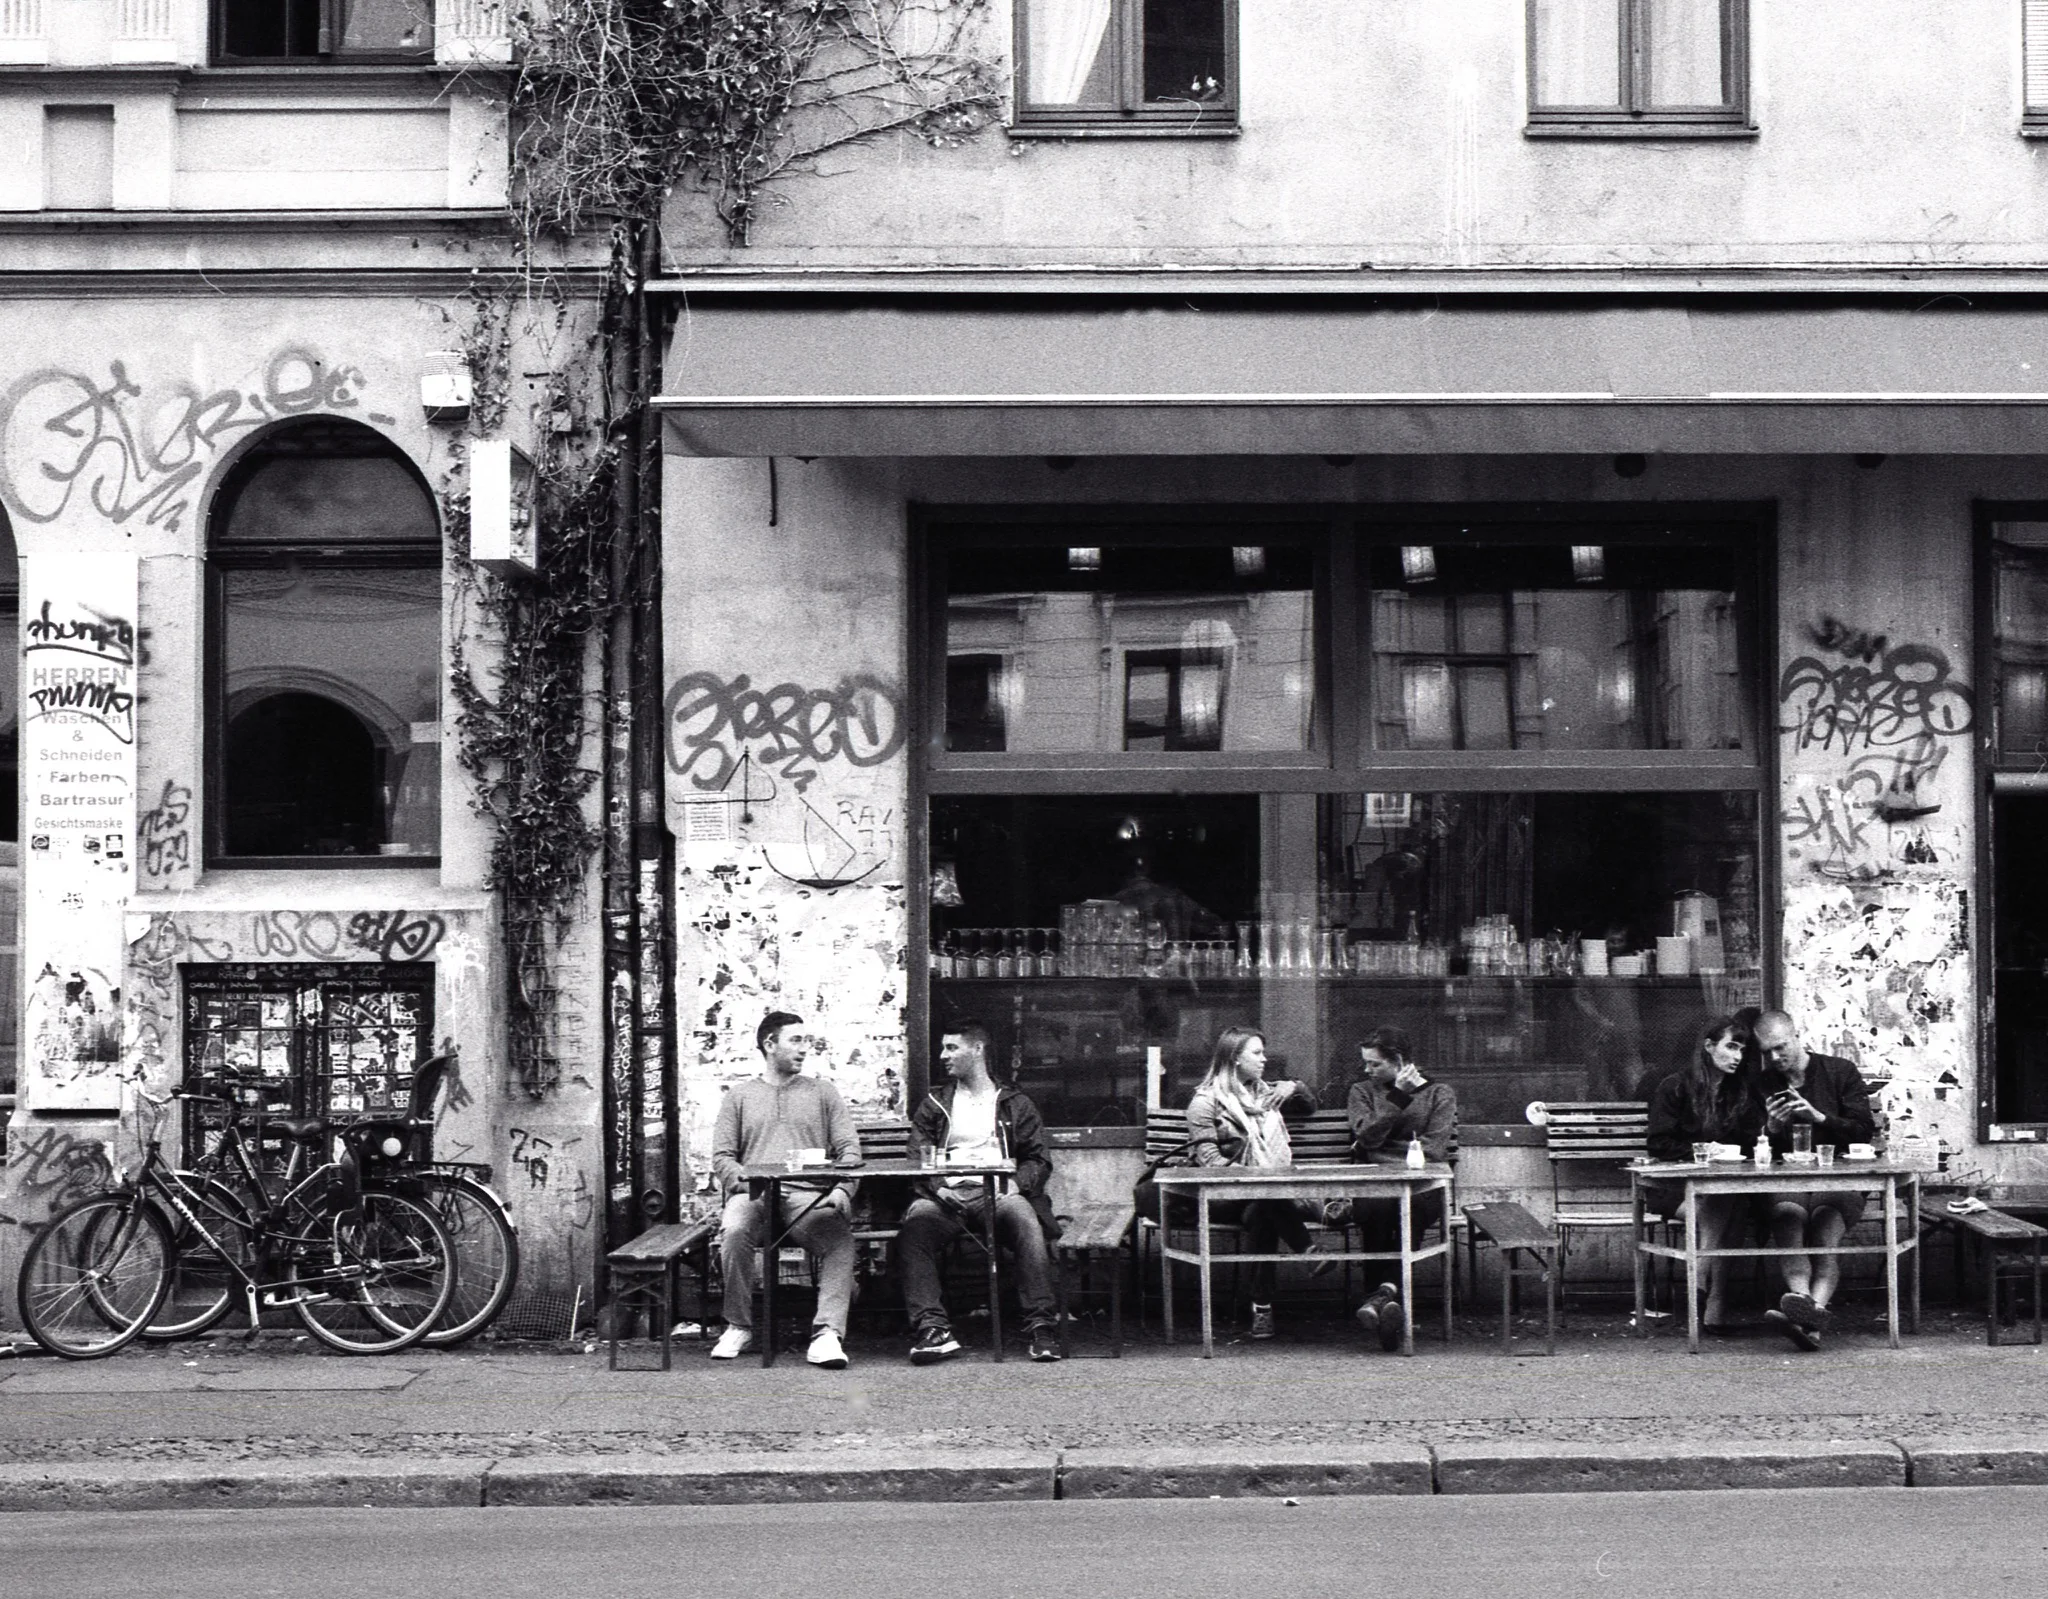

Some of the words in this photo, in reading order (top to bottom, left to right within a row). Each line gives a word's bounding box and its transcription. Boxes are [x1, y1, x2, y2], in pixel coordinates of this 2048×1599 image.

[33, 667, 127, 686] HERREN
[72, 730, 83, 742] &
[40, 748, 122, 761] Schneiden
[40, 793, 125, 806] Bartrasur
[34, 816, 124, 830] Gesichtsmaske
